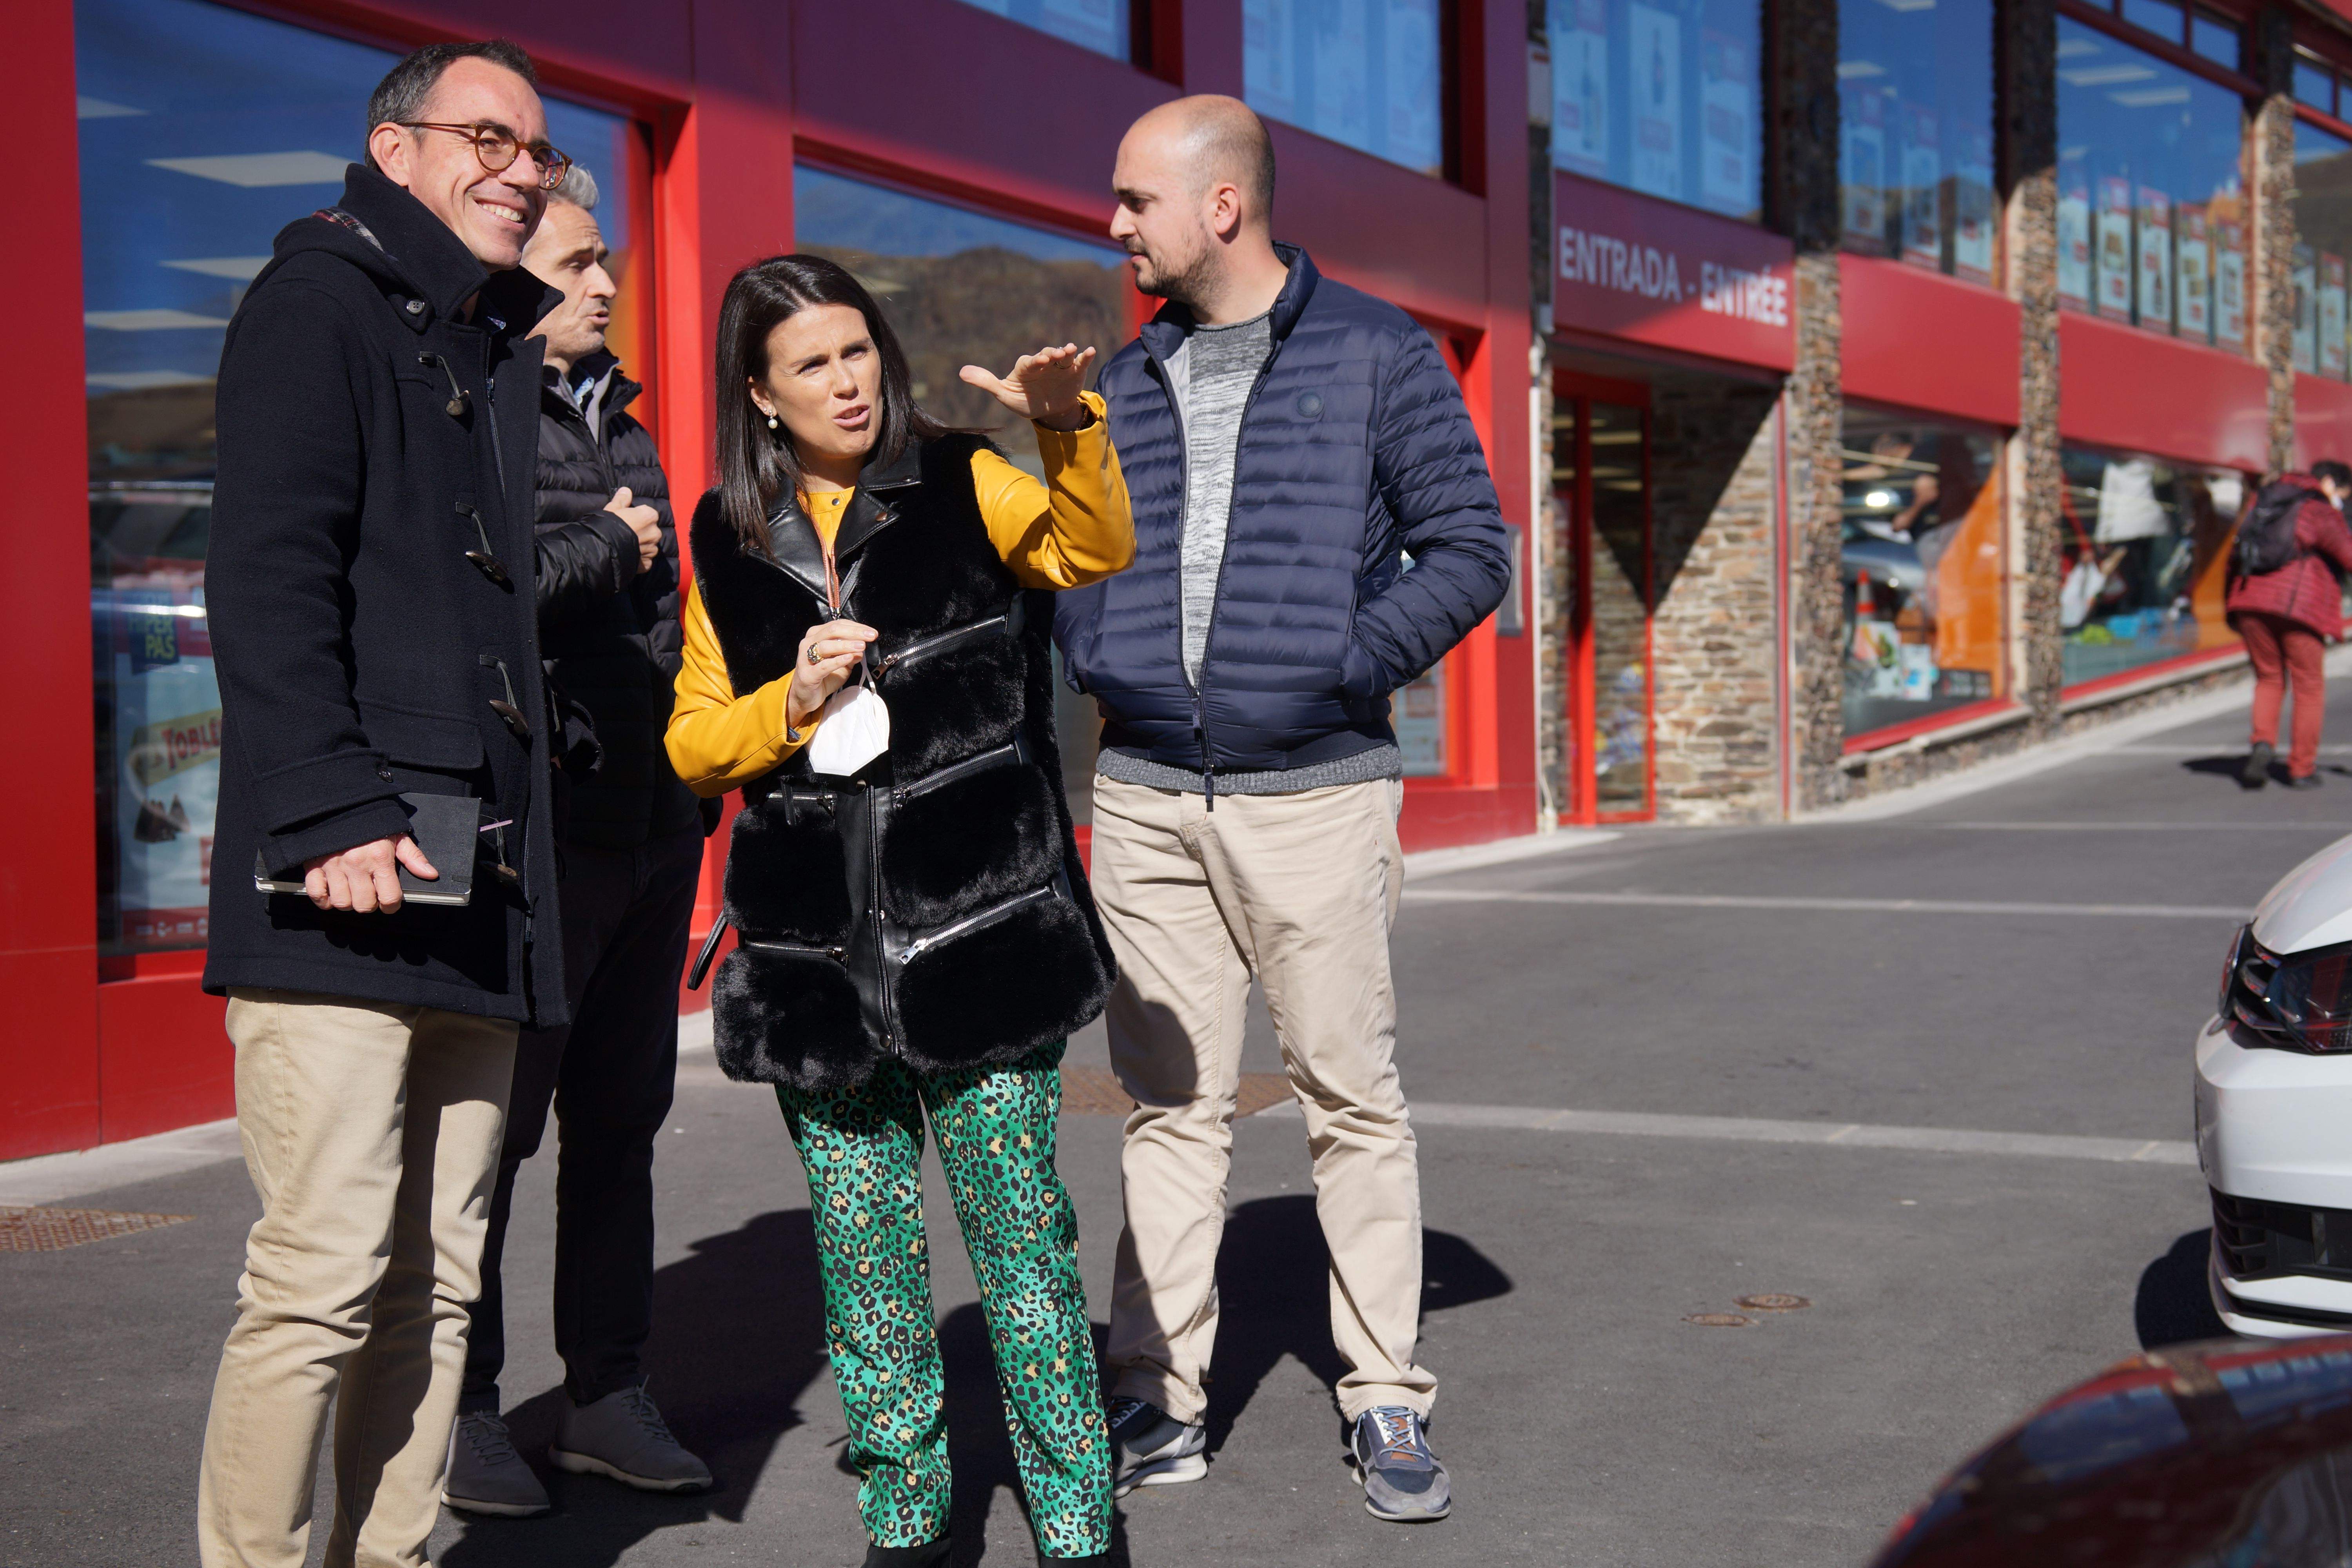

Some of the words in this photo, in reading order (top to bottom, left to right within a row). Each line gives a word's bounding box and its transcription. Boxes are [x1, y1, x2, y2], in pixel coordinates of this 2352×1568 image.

[1559, 226, 1682, 303] ENTRADA
[1700, 260, 1788, 327] ENTRÉE
[161, 717, 221, 769] TOBLE
